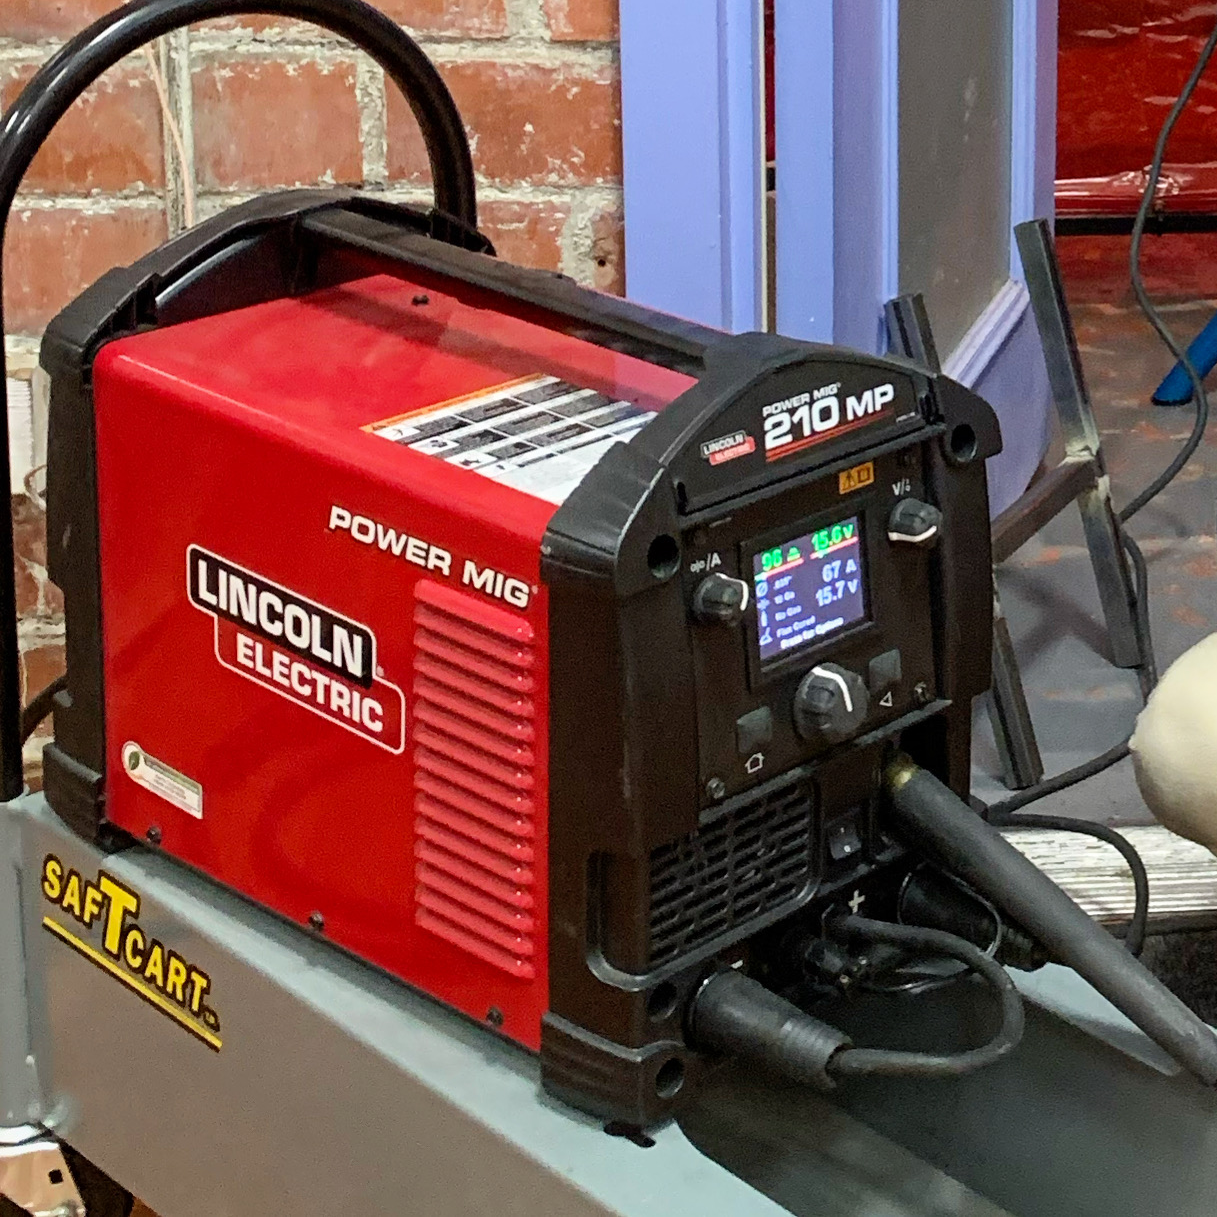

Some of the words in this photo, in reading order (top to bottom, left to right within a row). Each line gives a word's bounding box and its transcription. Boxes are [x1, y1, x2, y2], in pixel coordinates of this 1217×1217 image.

[762, 392, 810, 417] POWER
[812, 383, 838, 401] MIG
[764, 396, 840, 450] 210
[846, 383, 894, 421] MP
[703, 434, 745, 456] LINCOLN
[329, 505, 451, 576] POWER
[462, 559, 530, 609] MIG
[822, 559, 842, 583] 67
[845, 558, 857, 574] A
[197, 559, 364, 678] LINCOLN
[815, 580, 846, 607] 15.7
[236, 633, 384, 733] ELECTRIC
